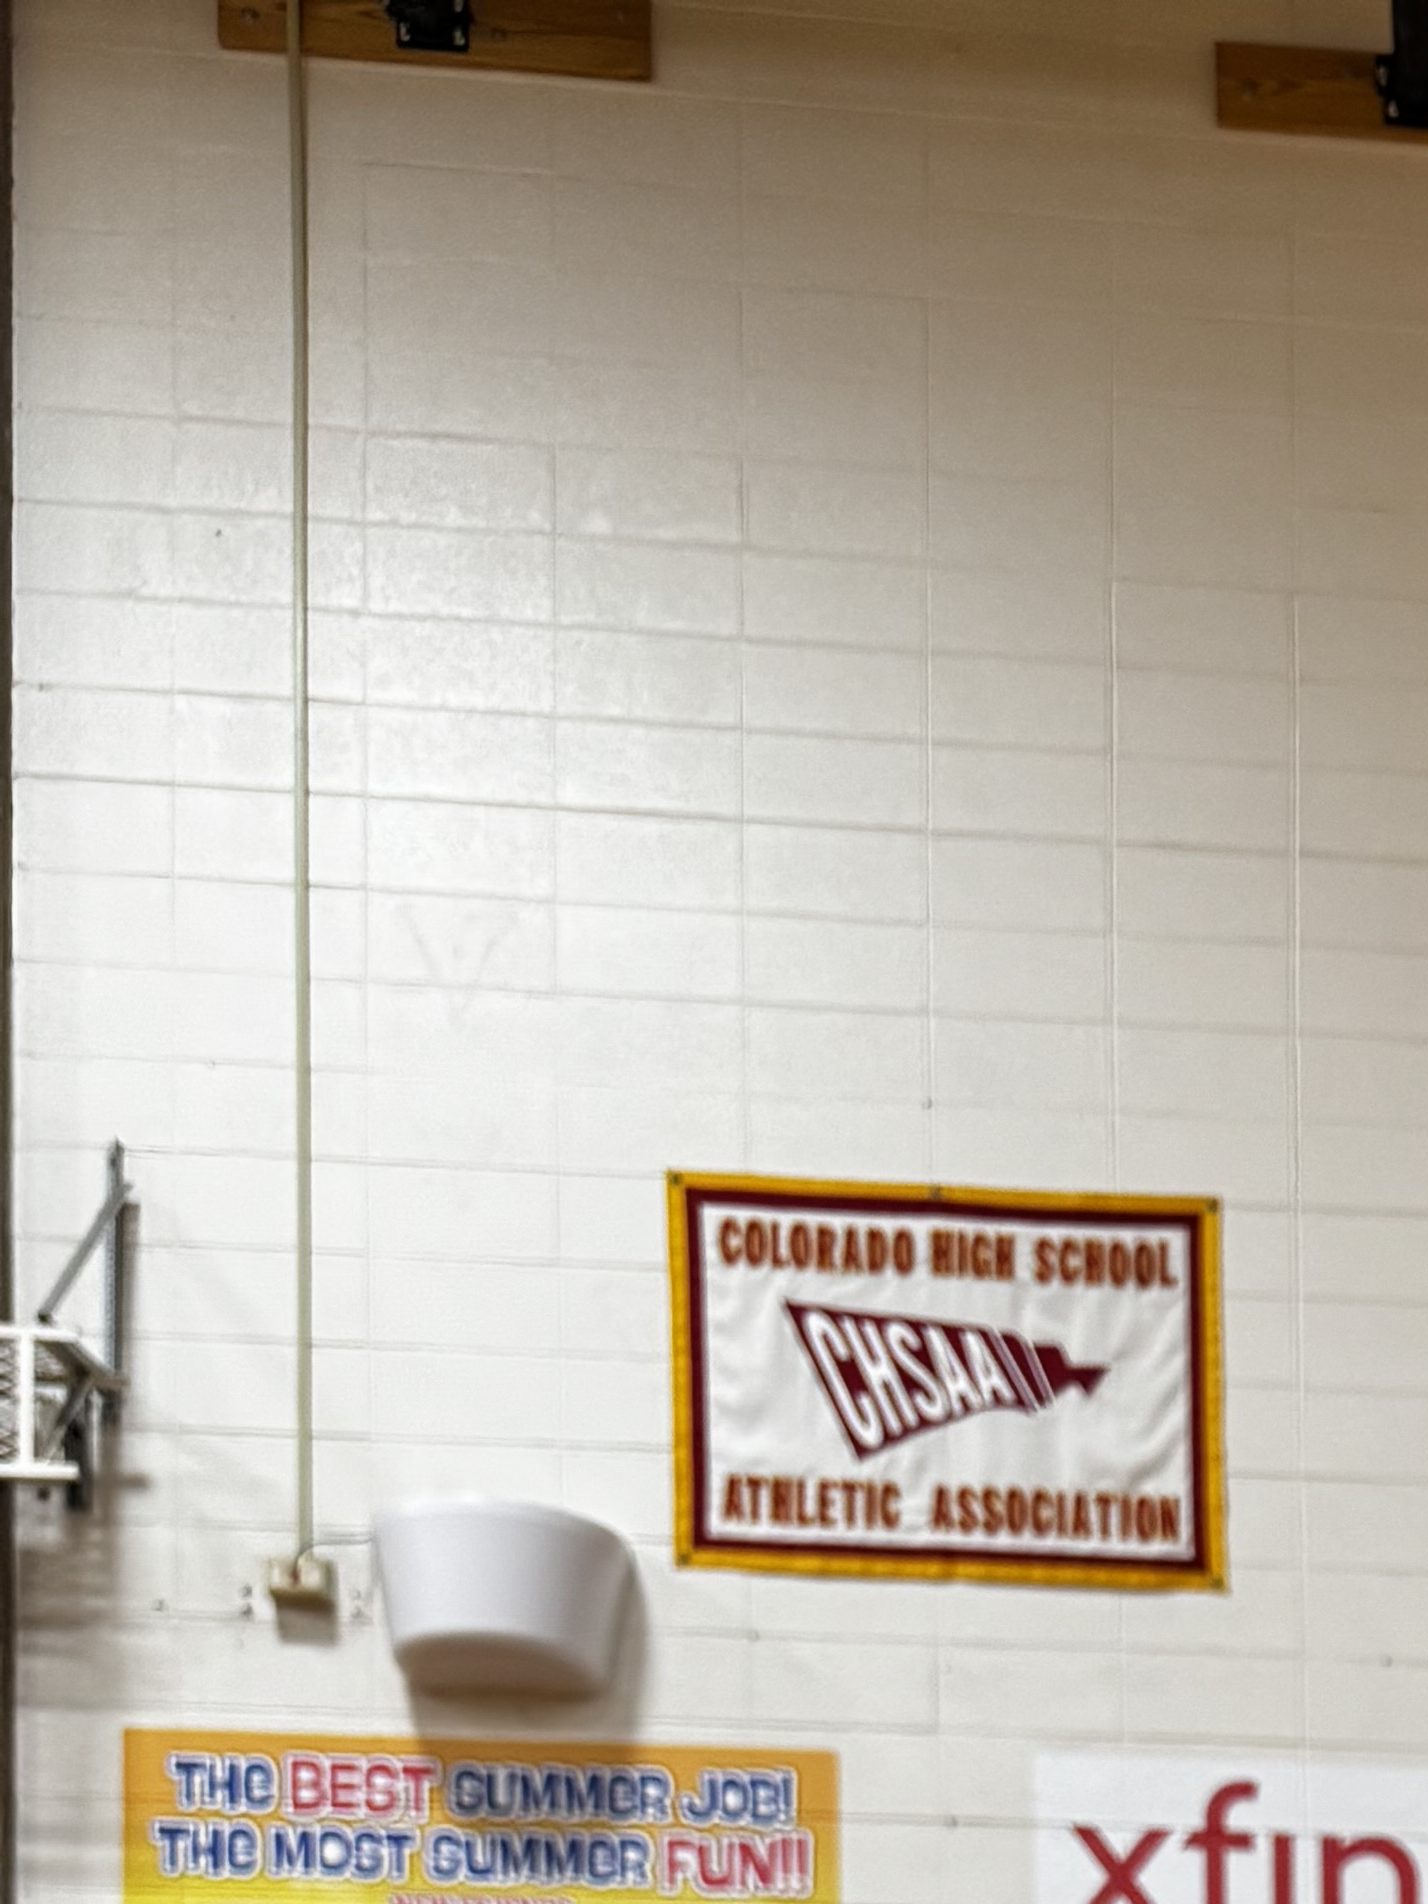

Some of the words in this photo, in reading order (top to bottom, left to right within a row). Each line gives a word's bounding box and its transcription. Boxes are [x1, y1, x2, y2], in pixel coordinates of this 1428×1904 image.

[719, 1217, 916, 1277] COLORADO
[931, 1231, 1015, 1282] HIGH
[1034, 1237, 1178, 1289] SCHOOL
[804, 1309, 1008, 1449] CHSAA
[722, 1474, 902, 1529] ATHLETIC
[930, 1486, 1180, 1542] ASSOCIATION
[288, 1757, 436, 1816] BEST
[682, 1769, 796, 1824] JOB!
[271, 1828, 413, 1880] MOST
[662, 1834, 812, 1893] FUN!!
